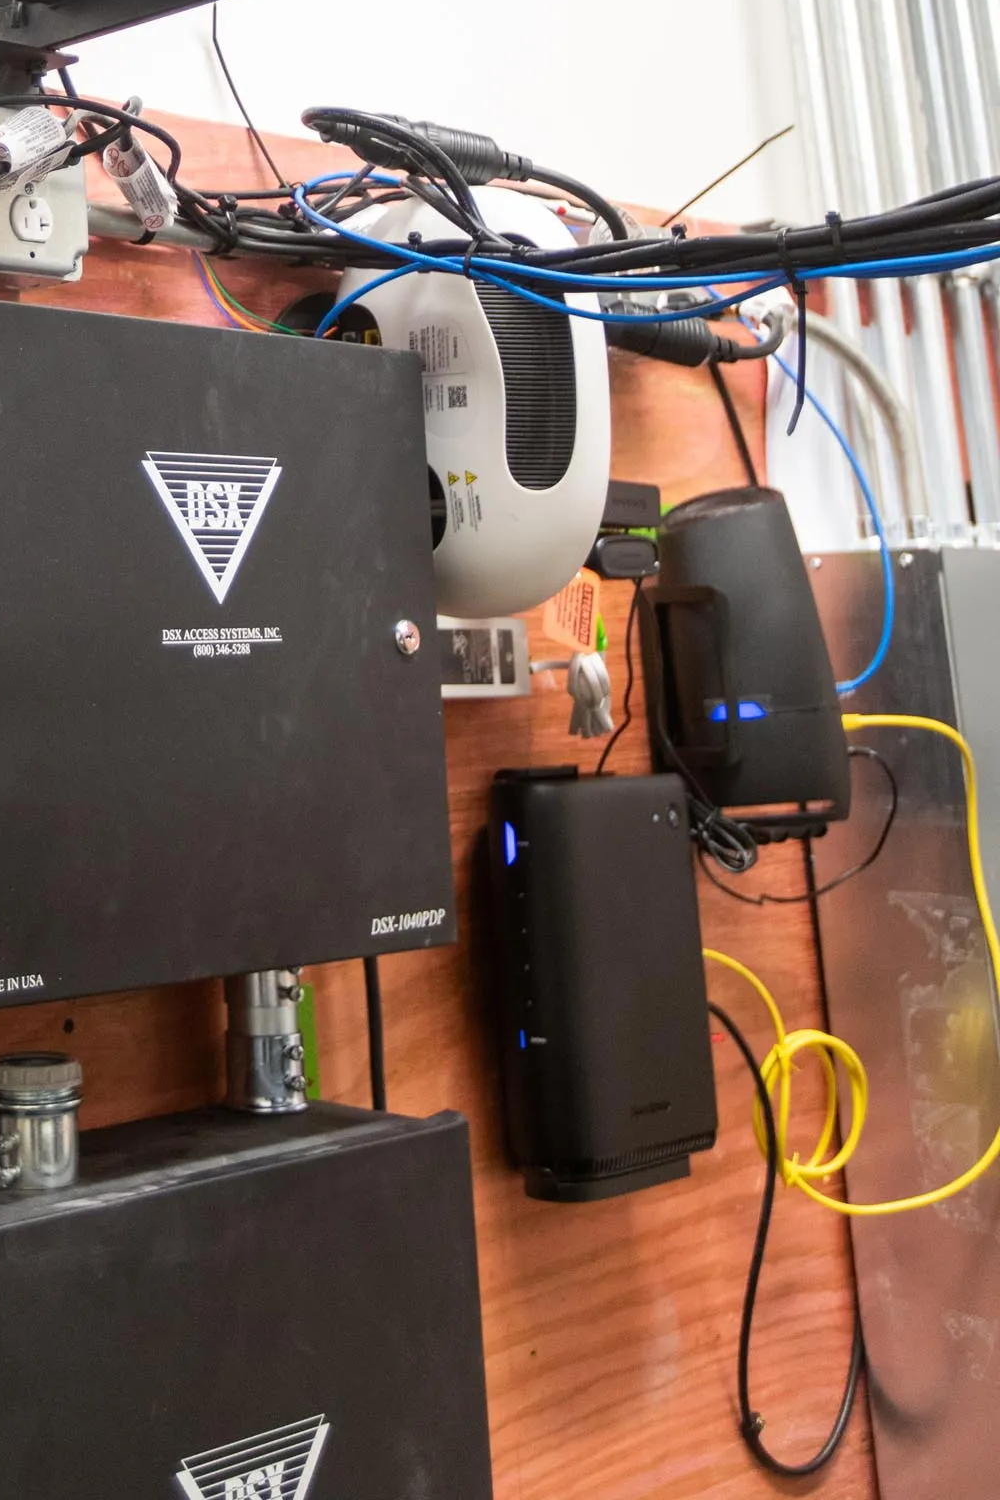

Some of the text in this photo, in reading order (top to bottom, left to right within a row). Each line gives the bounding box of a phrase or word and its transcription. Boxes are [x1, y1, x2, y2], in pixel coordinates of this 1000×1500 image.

[186, 481, 244, 529] DSX
[162, 627, 282, 641] DSX ACCESS SYSTEMS, INC.
[193, 643, 250, 658] (800) 346-5288
[371, 908, 446, 936] DSX-1040PDP
[7, 976, 20, 991] IN
[21, 974, 44, 988] USA
